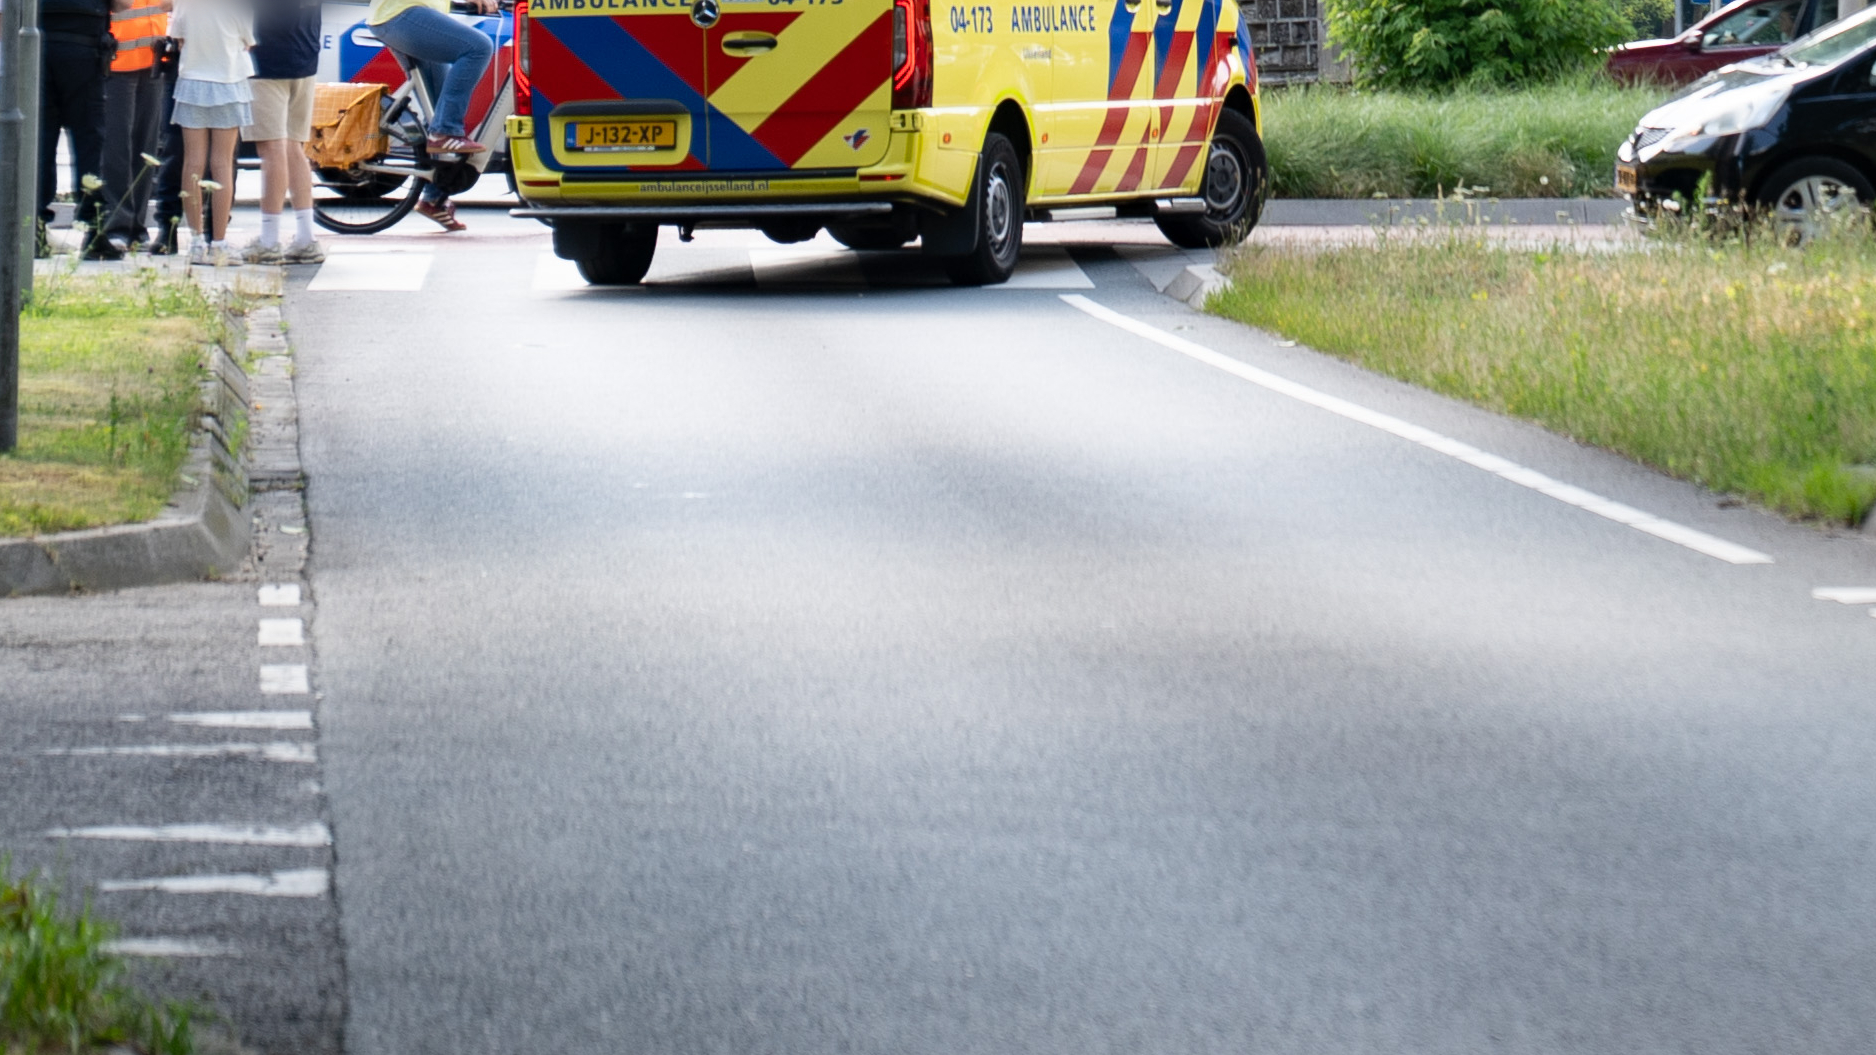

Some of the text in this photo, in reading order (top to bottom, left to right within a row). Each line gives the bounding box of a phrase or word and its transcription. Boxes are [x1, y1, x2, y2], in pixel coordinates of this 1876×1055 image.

[949, 5, 1096, 34] 04-173 AMBULANCE
[585, 124, 664, 145] J-132-XP
[639, 180, 770, 195] ambulanceijsselland.nl
